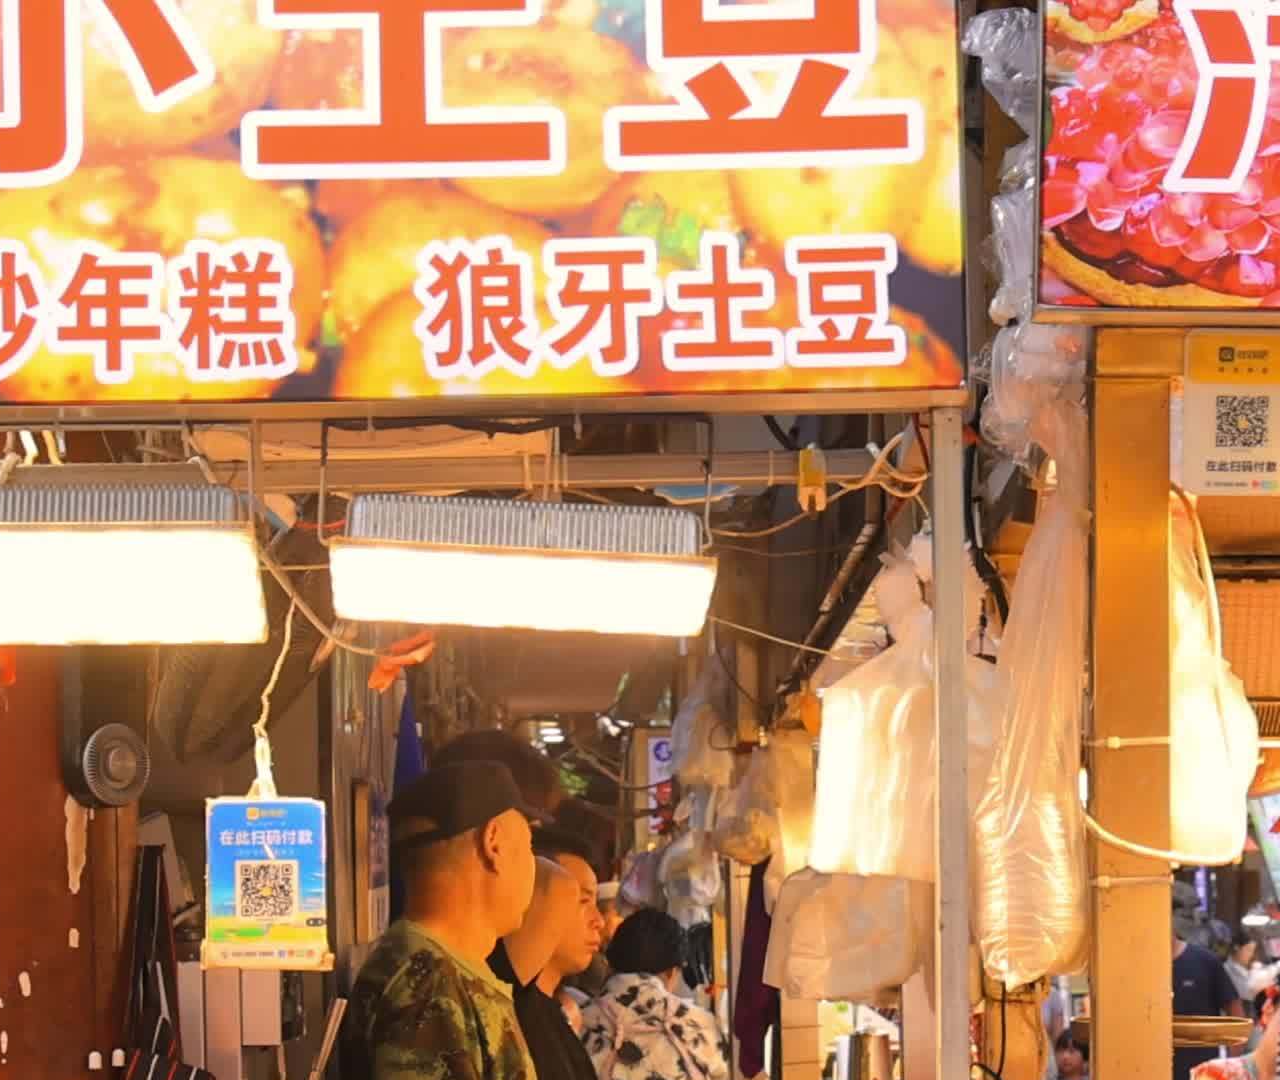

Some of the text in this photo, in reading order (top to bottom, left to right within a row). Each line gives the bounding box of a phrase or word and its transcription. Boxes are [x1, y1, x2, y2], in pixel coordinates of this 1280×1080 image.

[425, 245, 896, 367] 狼牙土豆
[1206, 460, 1278, 472] 在此扫码付款
[220, 829, 313, 846] 在此扫码付款
